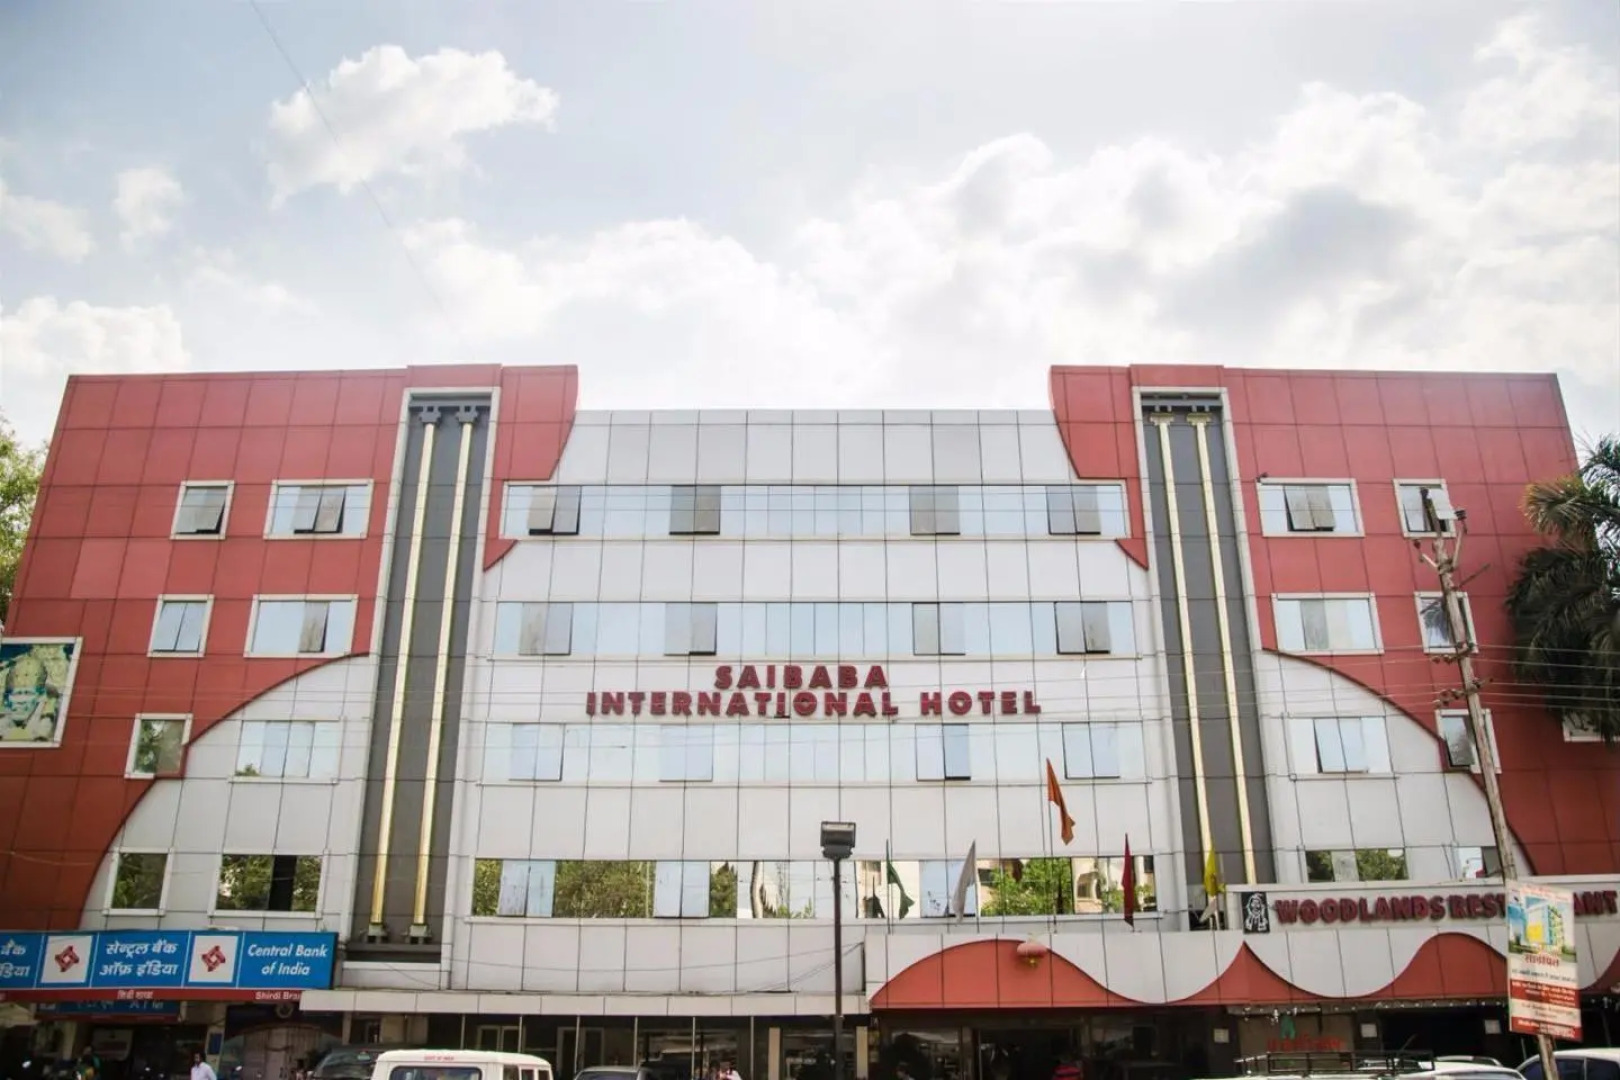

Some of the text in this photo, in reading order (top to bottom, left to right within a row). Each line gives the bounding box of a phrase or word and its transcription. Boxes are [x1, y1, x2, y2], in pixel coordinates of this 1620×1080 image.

[714, 665, 888, 690] SAIBABA
[586, 691, 1041, 717] INTERNATIONAL HOTEL
[1273, 895, 1445, 925] WOODLANDS
[151, 938, 179, 954] बैंक
[247, 943, 328, 958] Central Bank
[136, 960, 179, 977] इंडिया
[261, 961, 311, 976] of India
[255, 991, 281, 1000] Shirdi
